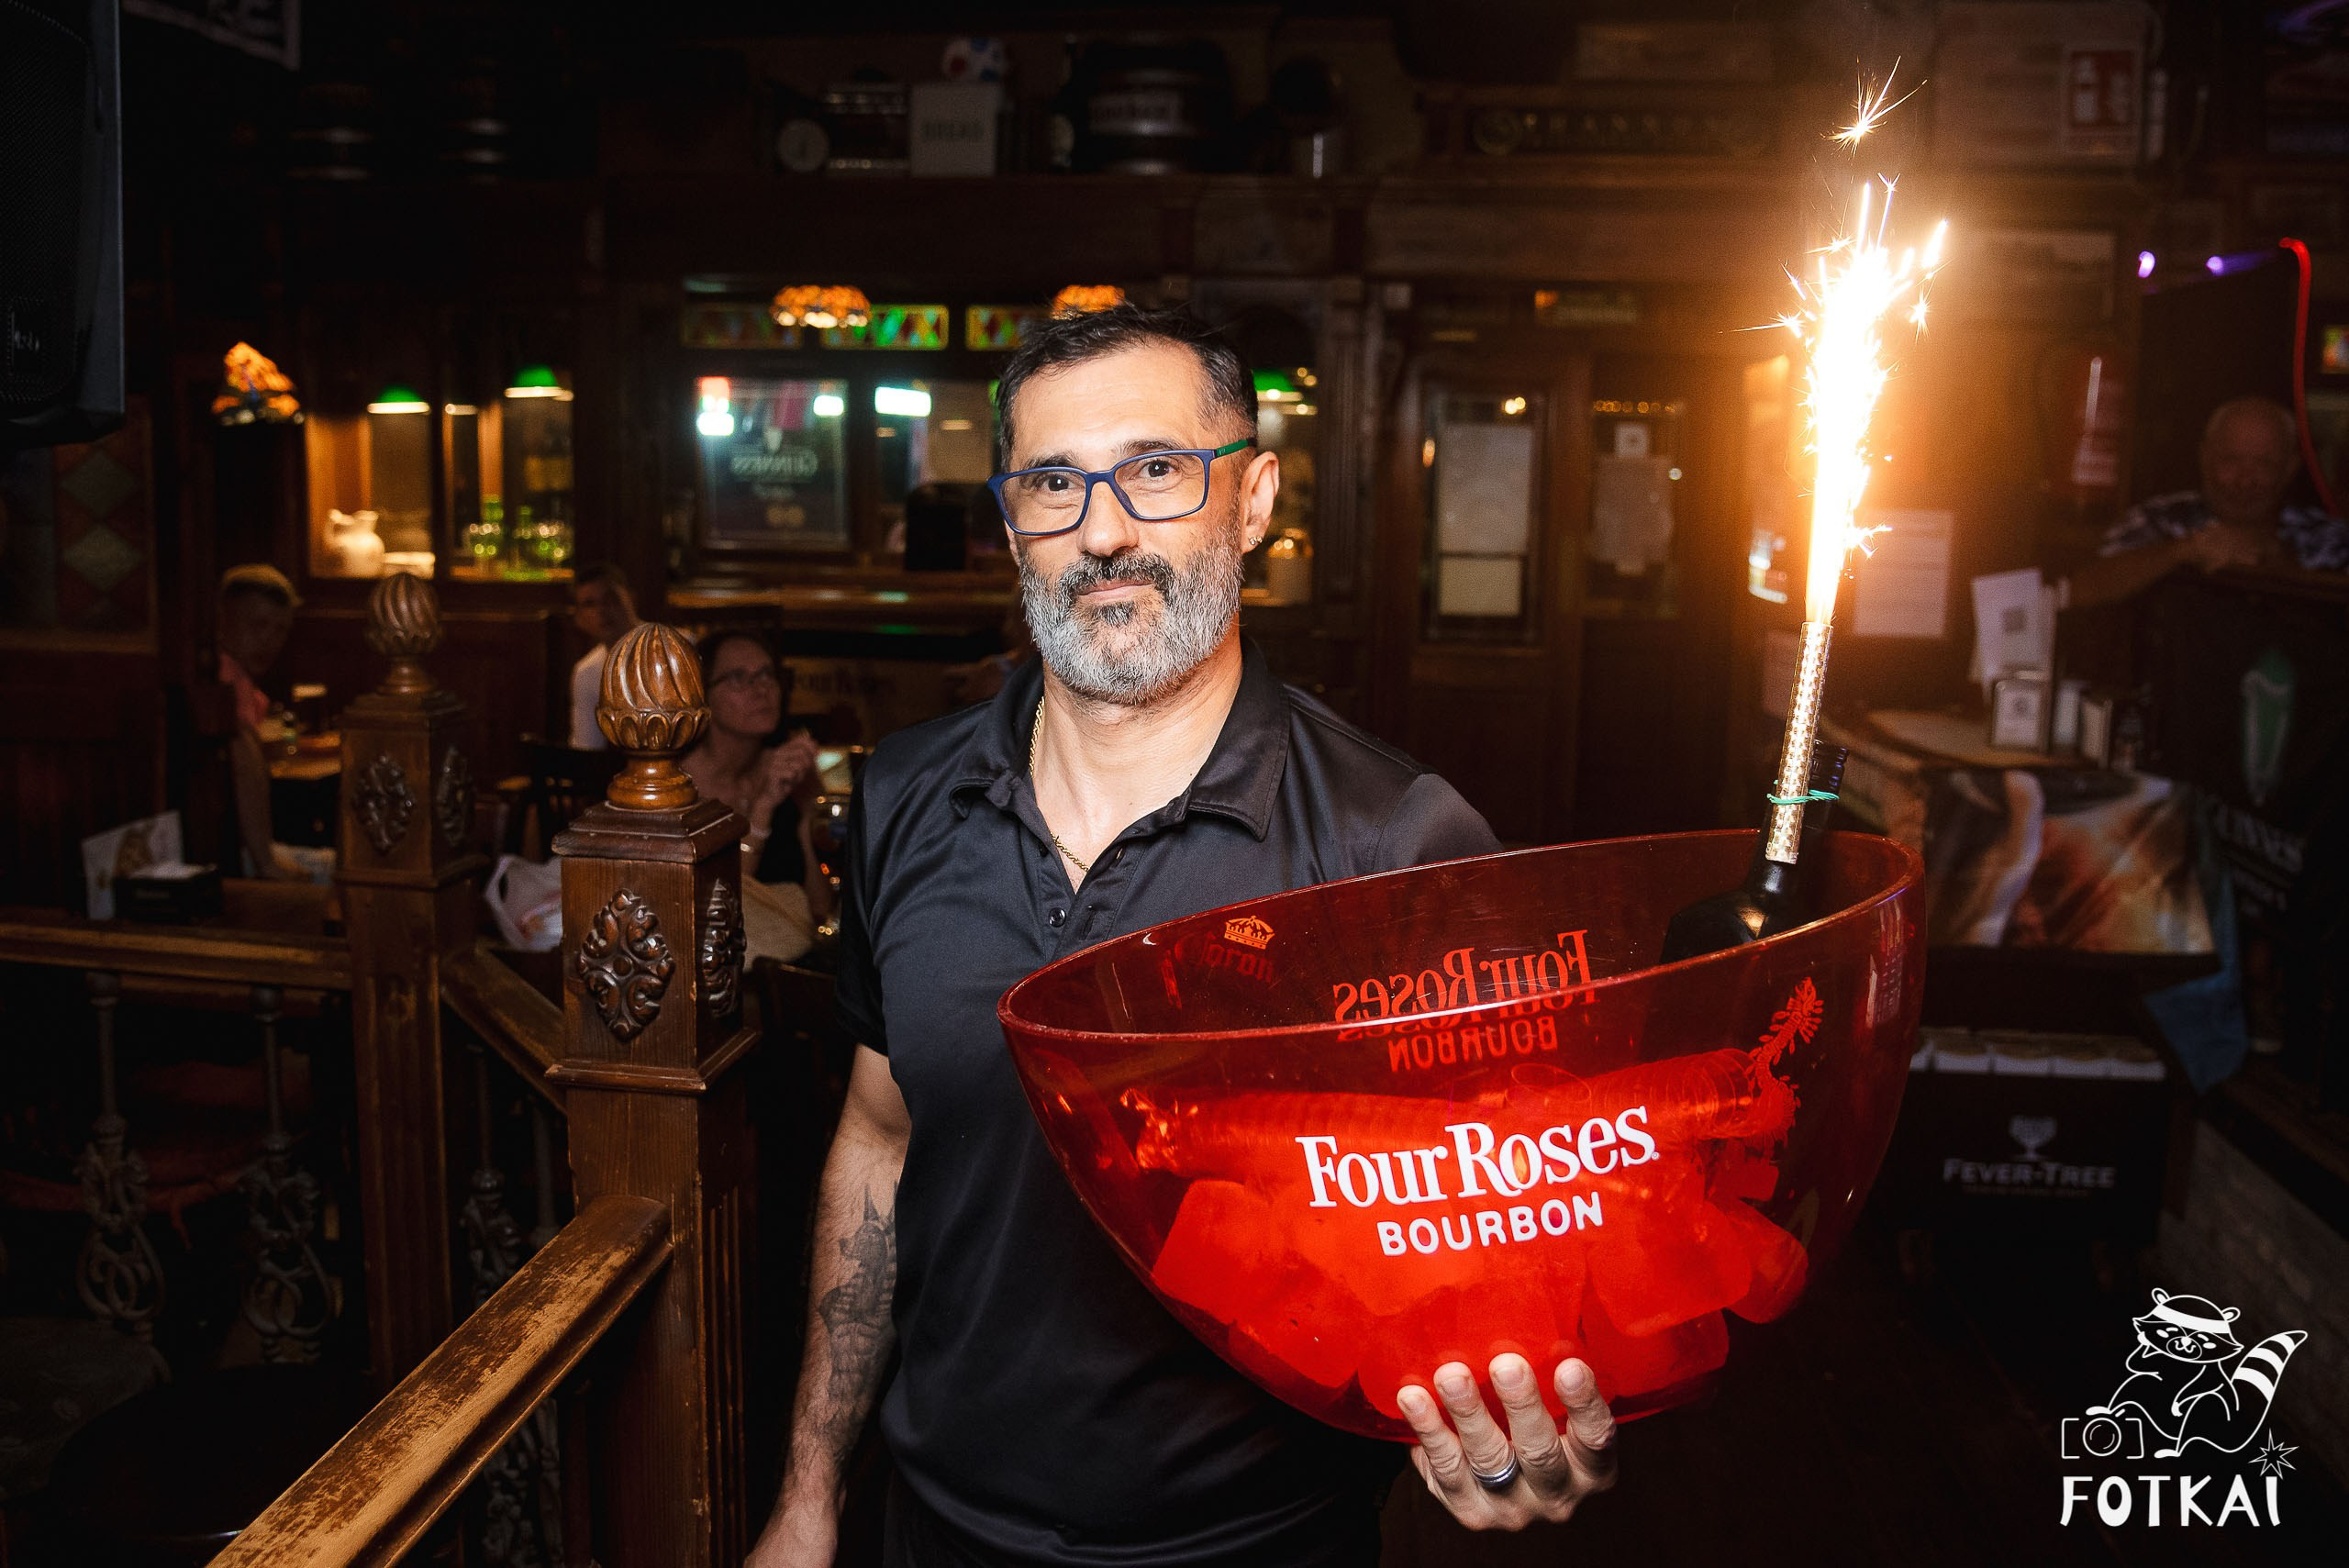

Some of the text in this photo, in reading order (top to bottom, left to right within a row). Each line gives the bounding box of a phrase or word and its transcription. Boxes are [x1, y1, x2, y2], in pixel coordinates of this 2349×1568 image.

[1174, 930, 1275, 984] Coron
[1295, 1105, 1656, 1208] Four Roses
[1376, 1191, 1604, 1256] BOURBON
